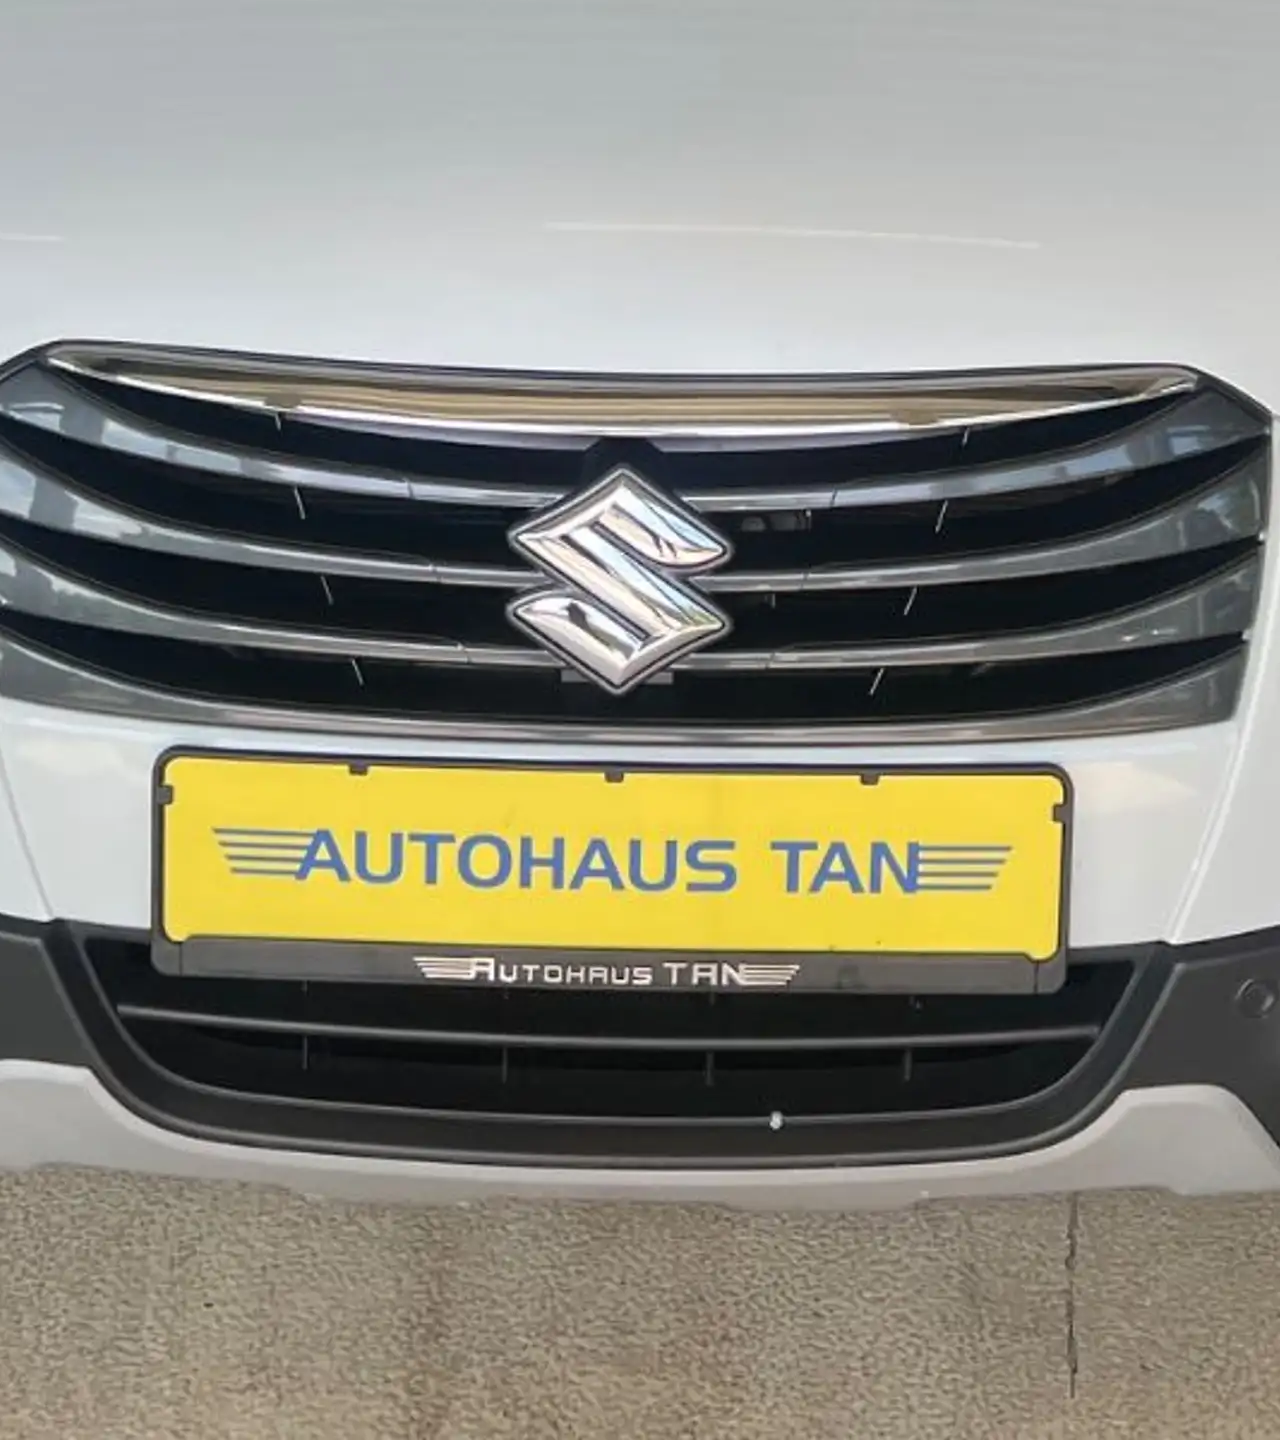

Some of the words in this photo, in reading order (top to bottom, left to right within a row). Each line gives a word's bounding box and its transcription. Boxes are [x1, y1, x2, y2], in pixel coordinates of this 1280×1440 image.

[294, 828, 738, 893] AUTOHAUS
[770, 841, 920, 894] TAN
[468, 957, 653, 986] AUTOHAUS
[663, 962, 742, 987] TAN
